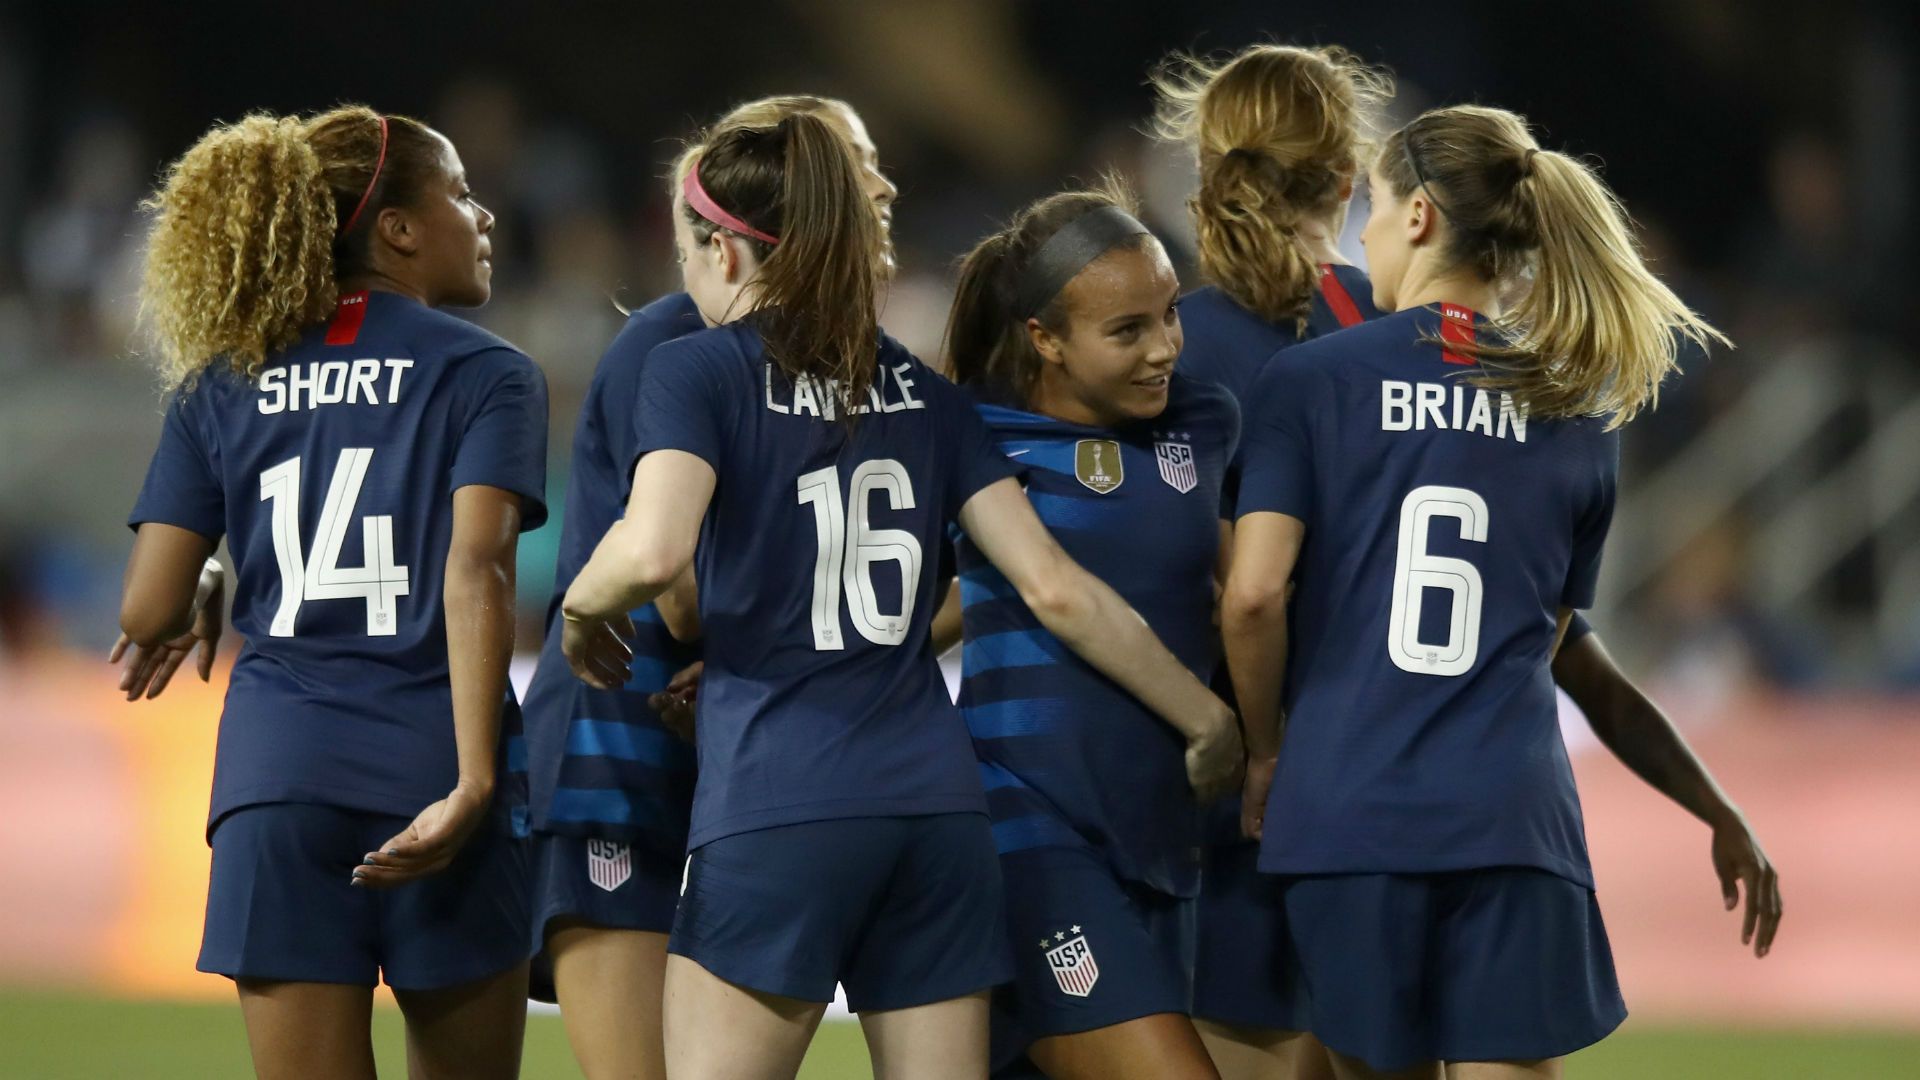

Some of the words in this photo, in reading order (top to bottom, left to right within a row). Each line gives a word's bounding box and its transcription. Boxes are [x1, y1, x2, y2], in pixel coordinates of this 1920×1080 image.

[1446, 309, 1468, 320] USA
[258, 359, 414, 415] SHORT
[765, 362, 925, 421] LAVLE
[1382, 380, 1530, 443] BRIAN
[1157, 444, 1190, 465] USA
[260, 448, 409, 637] 14
[797, 459, 922, 650] 16
[1388, 485, 1489, 676] 6
[1049, 940, 1086, 968] USA
